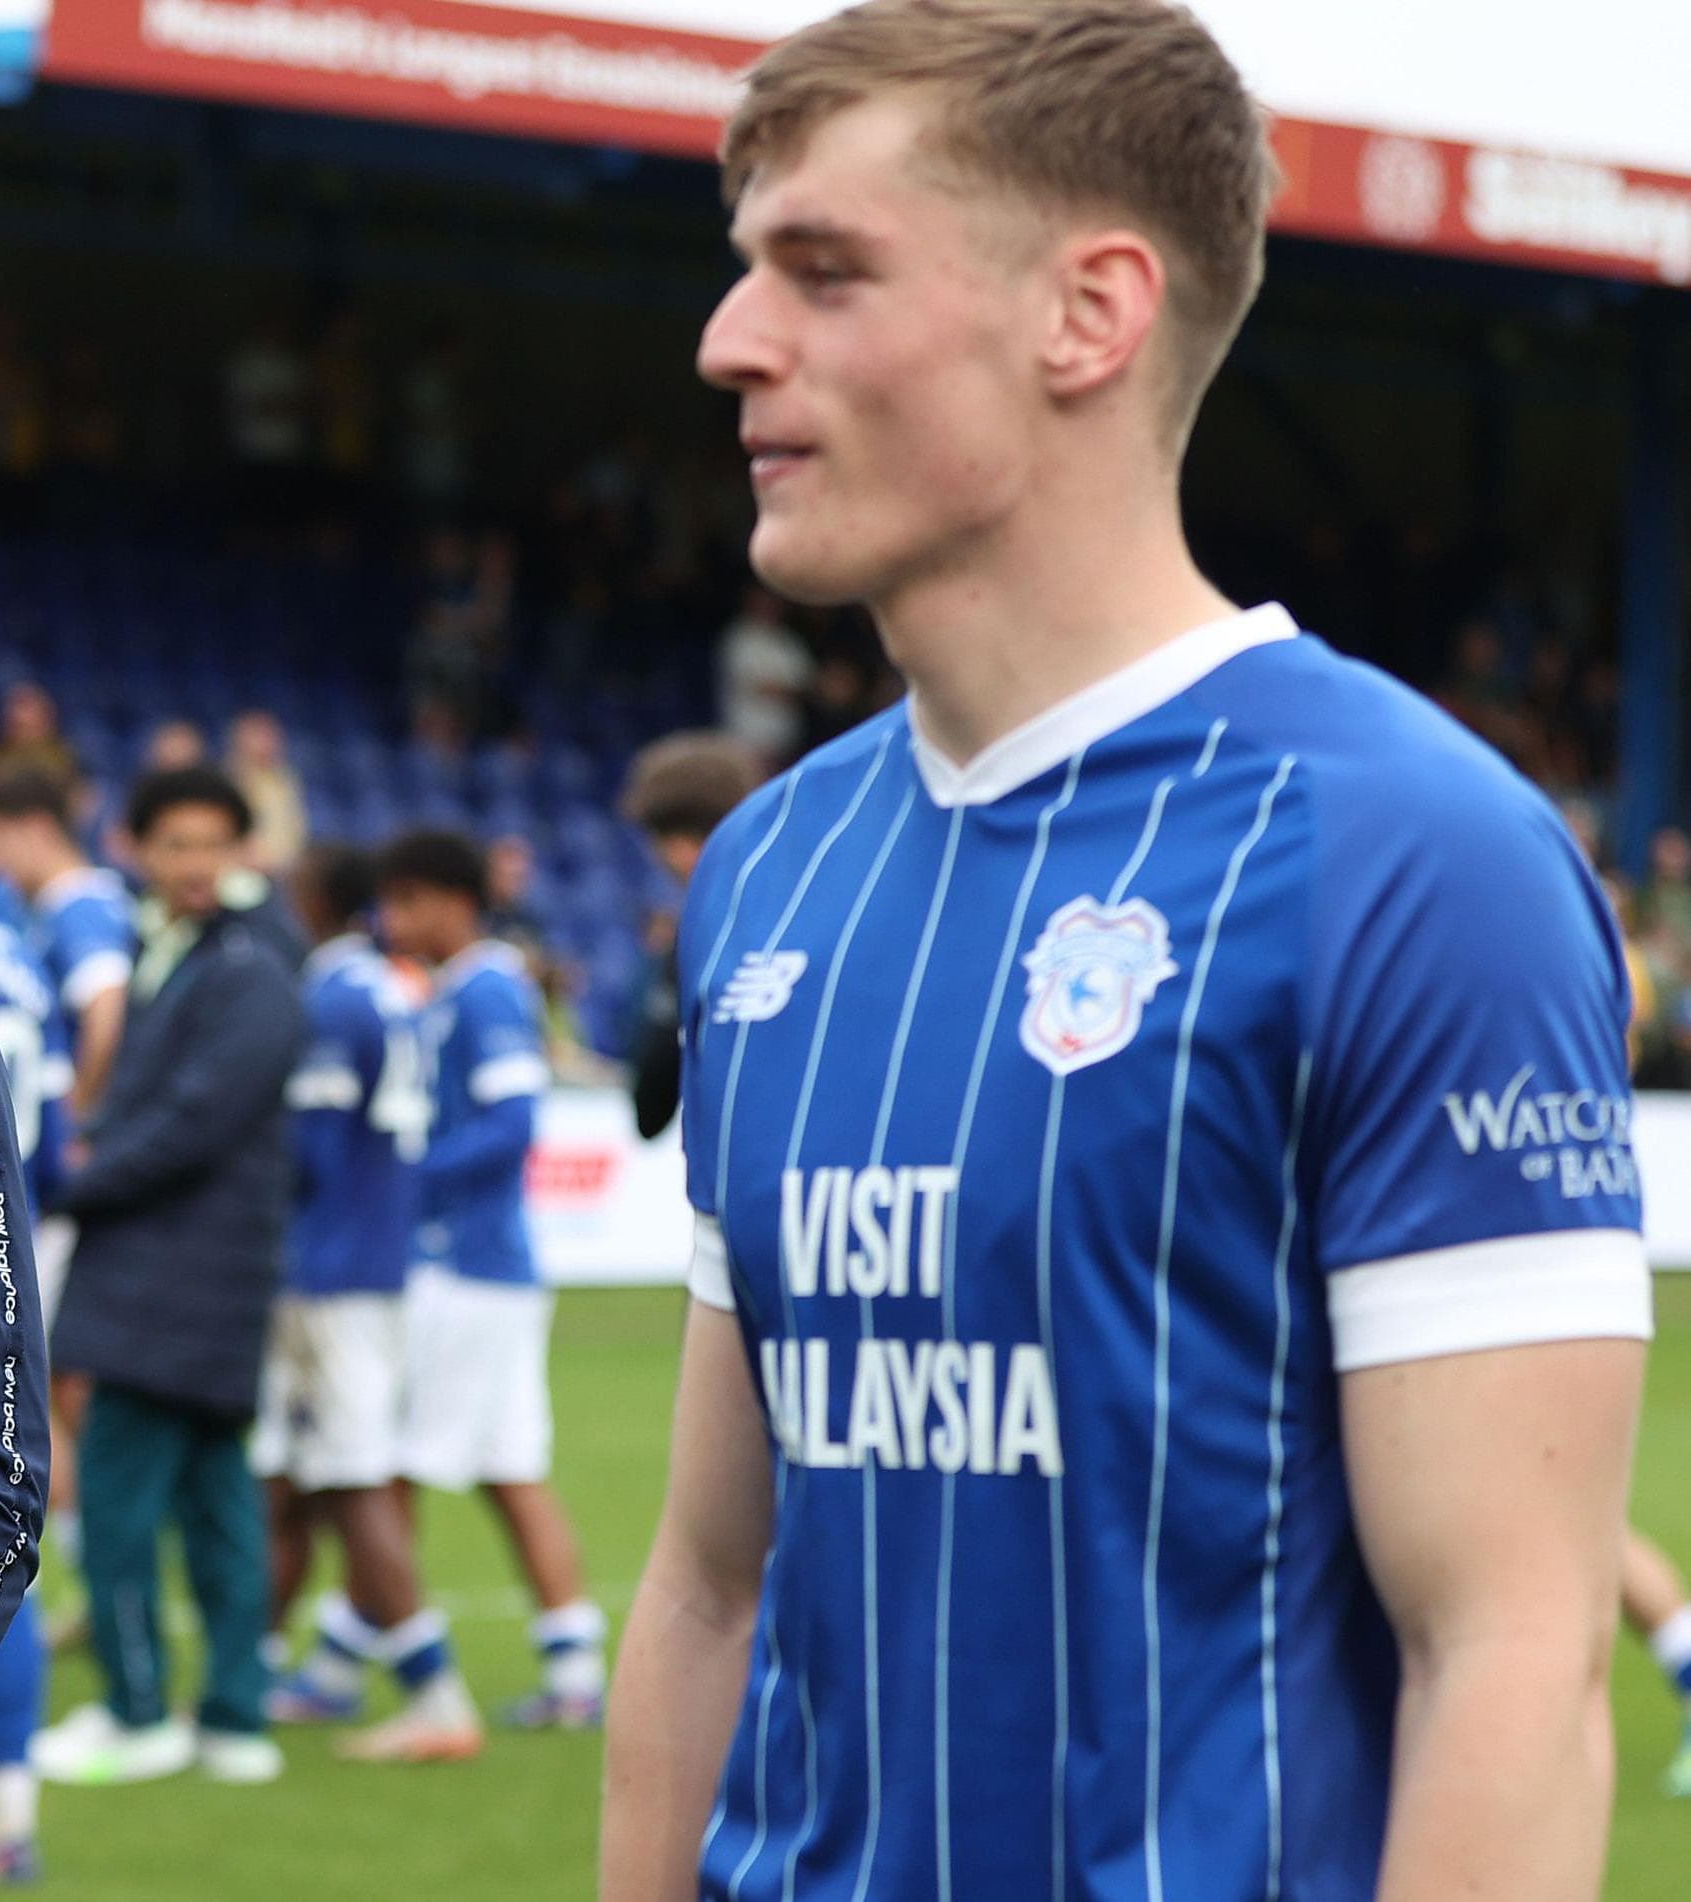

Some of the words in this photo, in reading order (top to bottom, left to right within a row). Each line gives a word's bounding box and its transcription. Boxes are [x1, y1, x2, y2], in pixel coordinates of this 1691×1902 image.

[781, 1165, 960, 1299] VISIT
[4, 1355, 17, 1400] new
[12, 1510, 29, 1552] nw
